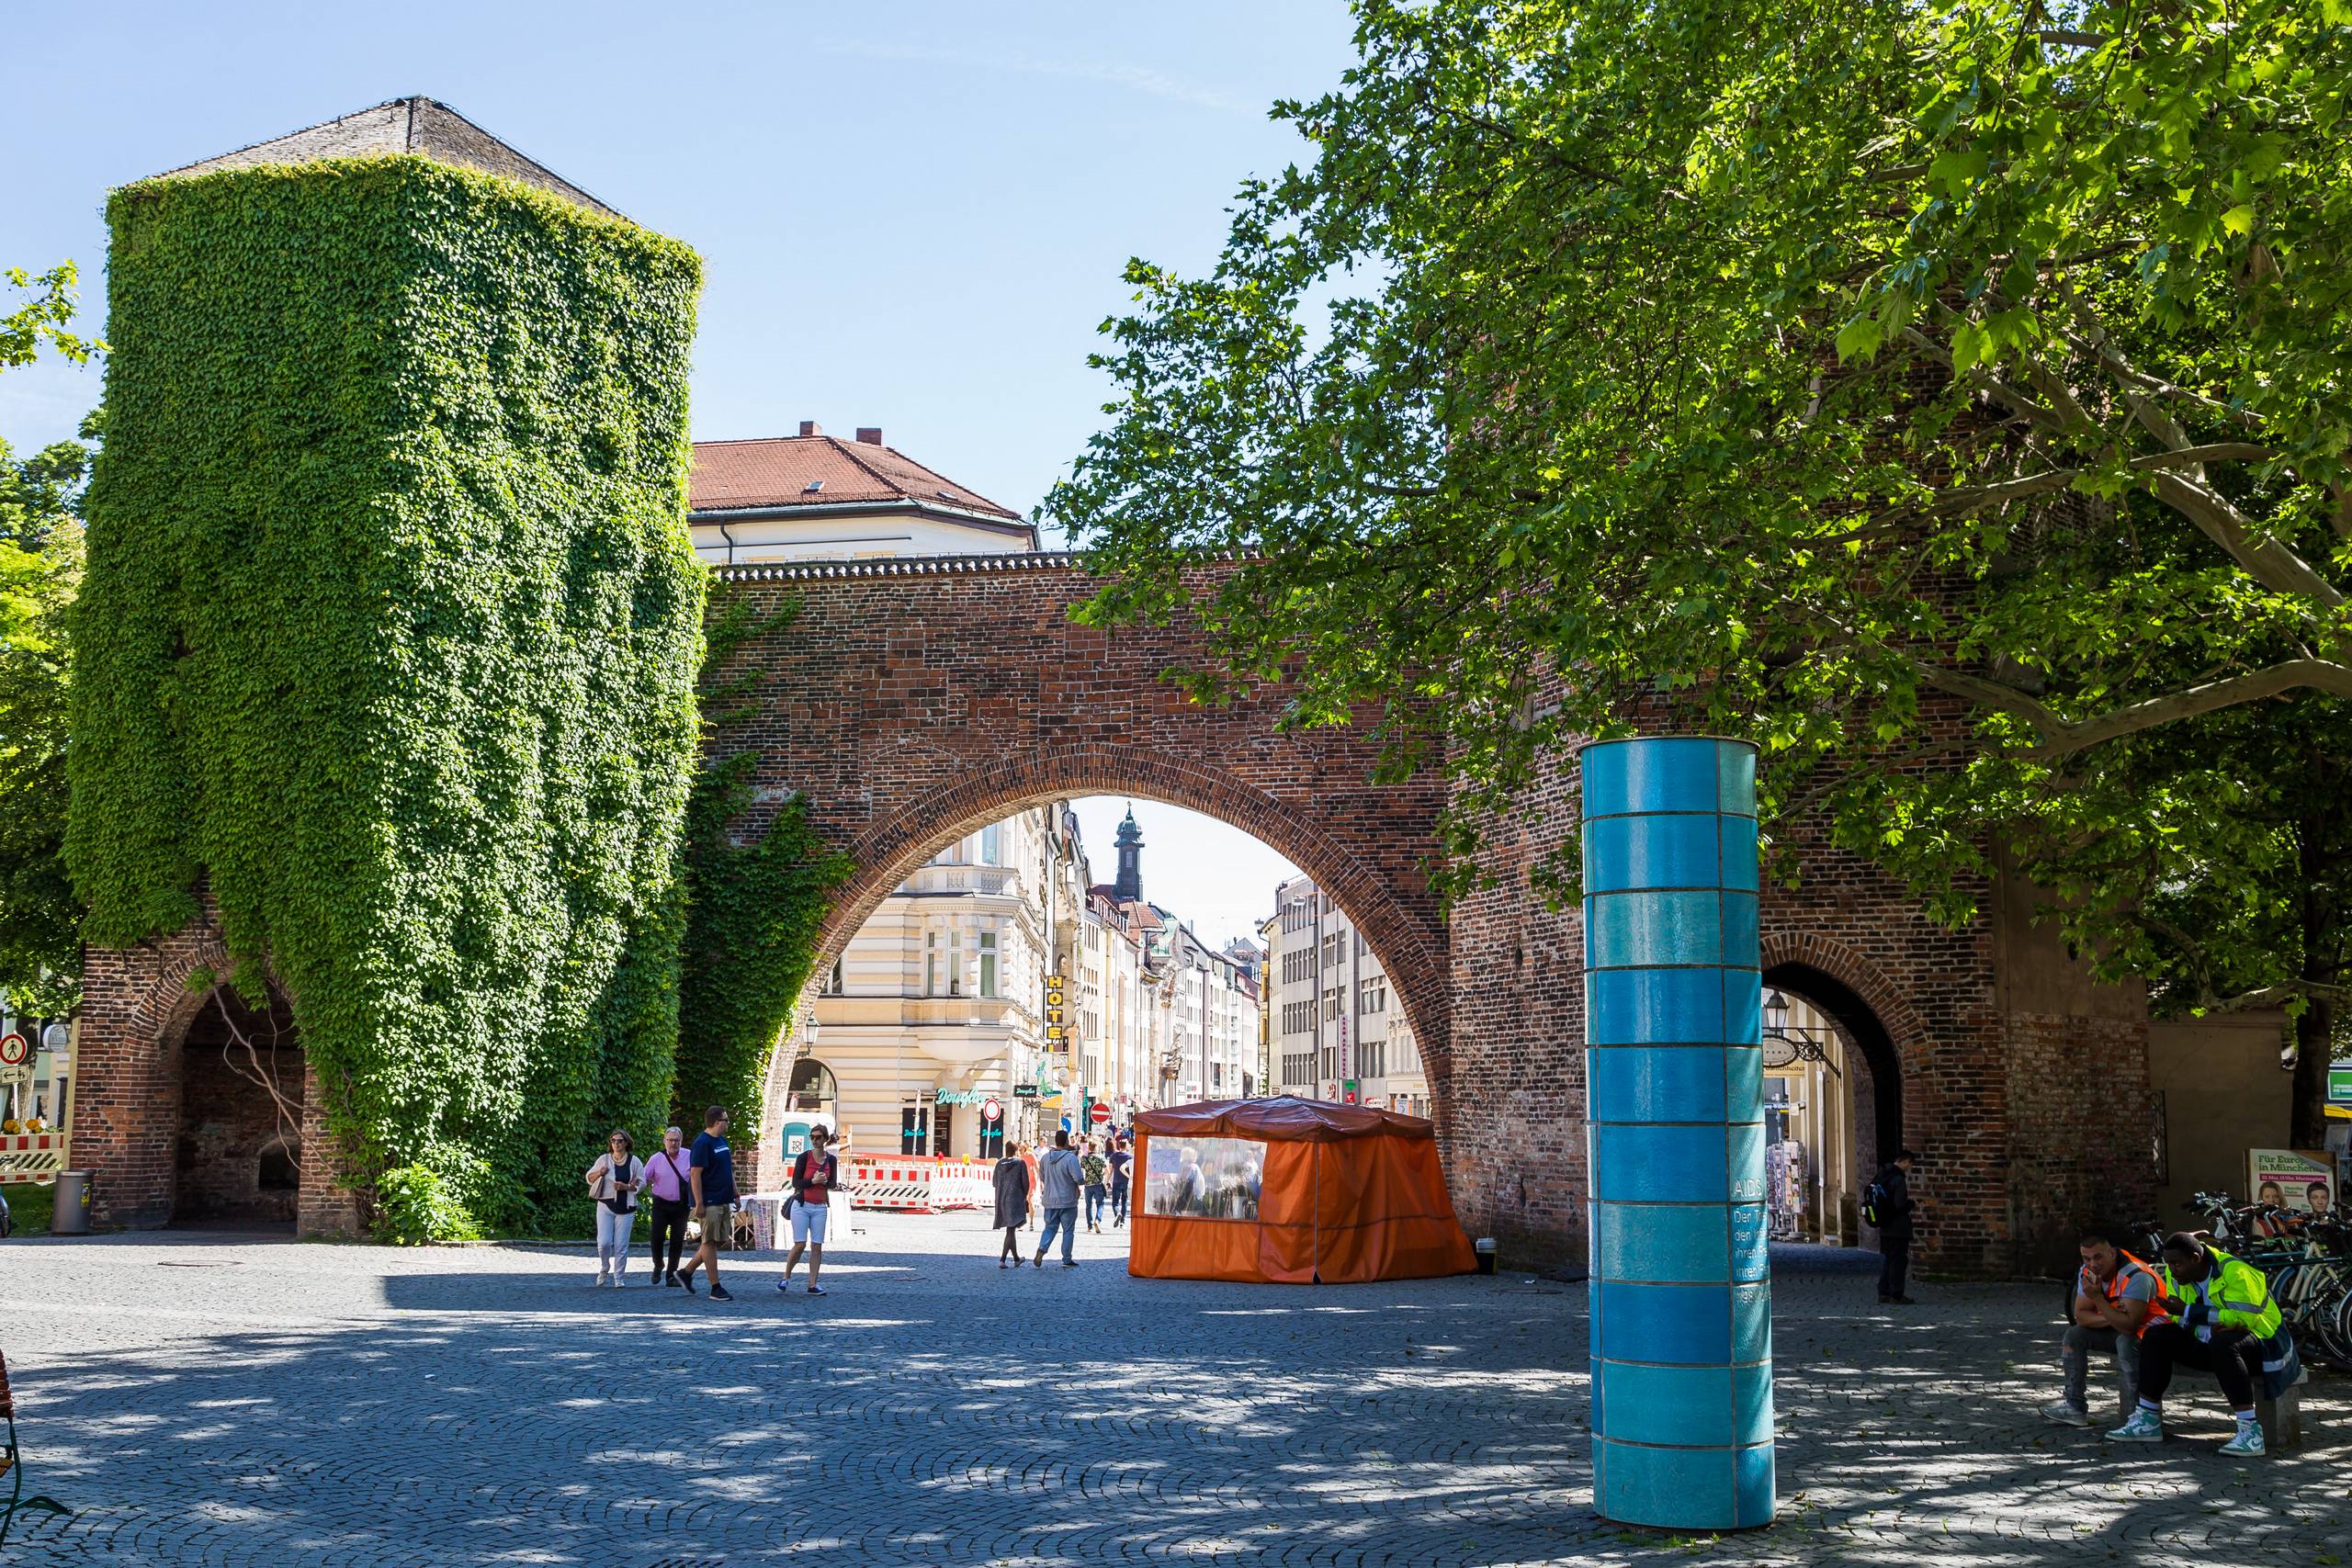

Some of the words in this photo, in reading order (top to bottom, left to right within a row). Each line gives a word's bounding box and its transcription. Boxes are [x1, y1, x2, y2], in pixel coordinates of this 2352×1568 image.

[903, 1127, 925, 1137] Doulas
[2258, 1155, 2275, 1163] Für
[1734, 1179, 1763, 1197] AIDS
